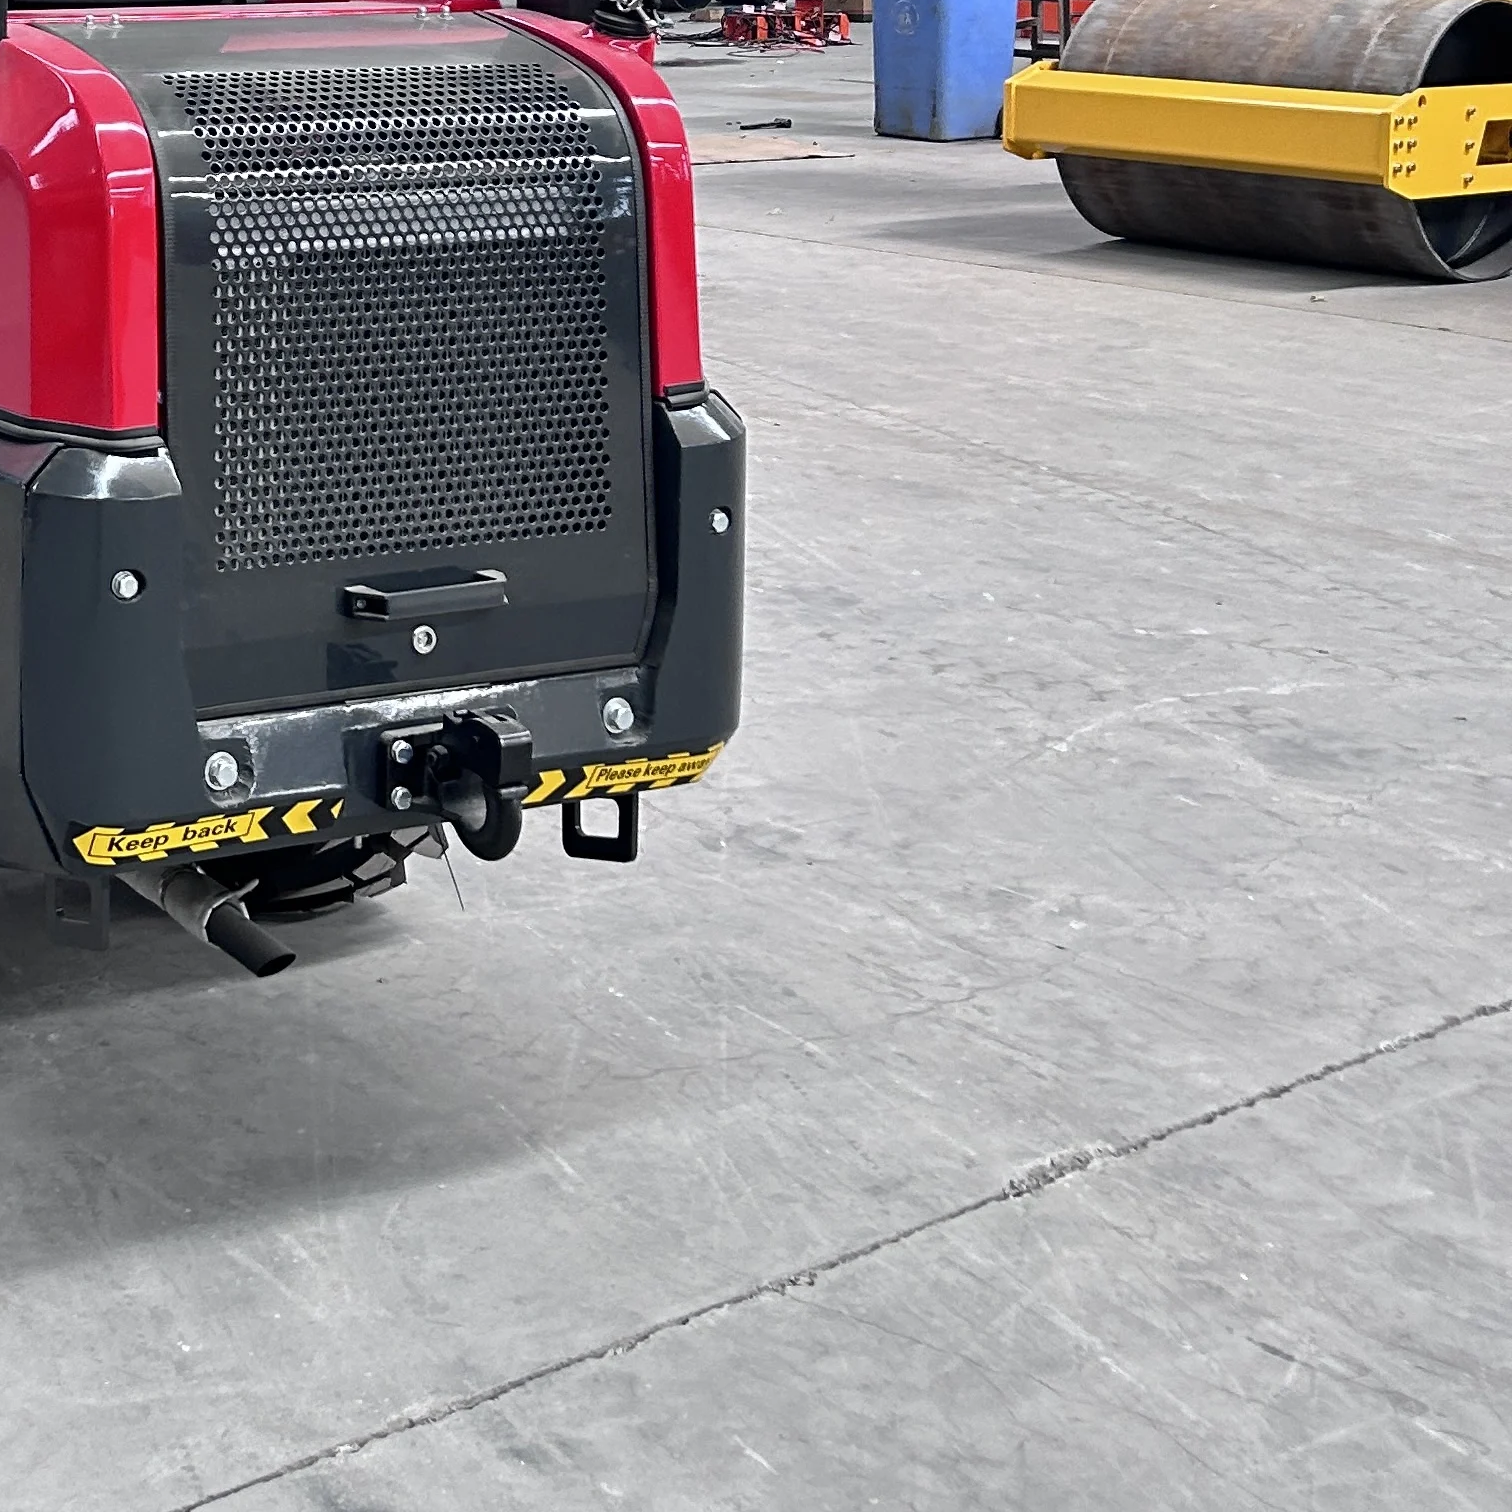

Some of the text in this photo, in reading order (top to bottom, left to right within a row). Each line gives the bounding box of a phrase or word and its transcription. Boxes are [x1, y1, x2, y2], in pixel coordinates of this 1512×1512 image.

[596, 767, 641, 782] Please
[642, 763, 676, 777] keep
[107, 818, 238, 852] Keep back
